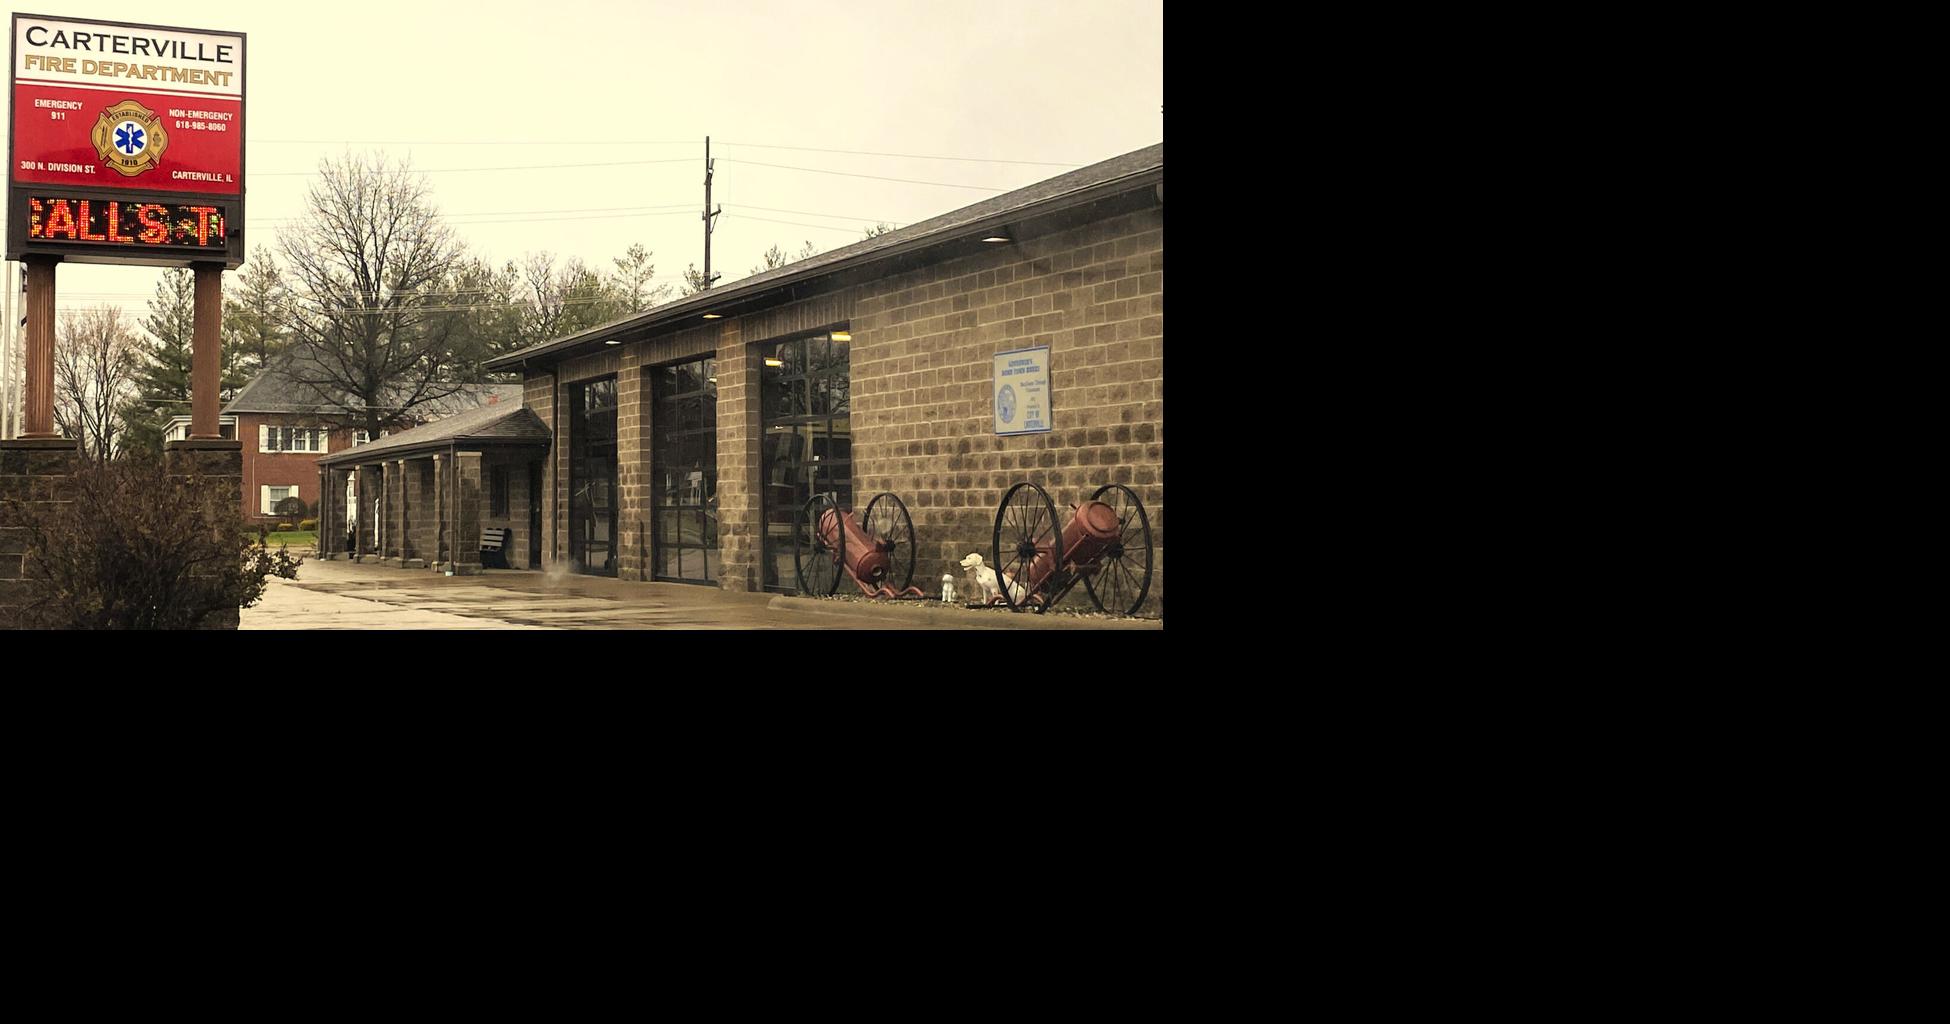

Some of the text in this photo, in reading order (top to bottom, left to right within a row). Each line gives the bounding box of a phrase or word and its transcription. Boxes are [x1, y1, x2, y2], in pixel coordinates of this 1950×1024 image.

[25, 26, 233, 63] CARTERVILLE
[24, 54, 233, 86] FIRE DEPARTMENT
[35, 98, 83, 110] EMERGENCY
[51, 111, 66, 120] 911
[112, 111, 149, 123] ESTABLISHED
[168, 109, 233, 121] NON-EMERGENCY
[20, 160, 96, 174] 300 N. DIVISION ST.
[172, 170, 233, 183] CARTERVILLE, IL
